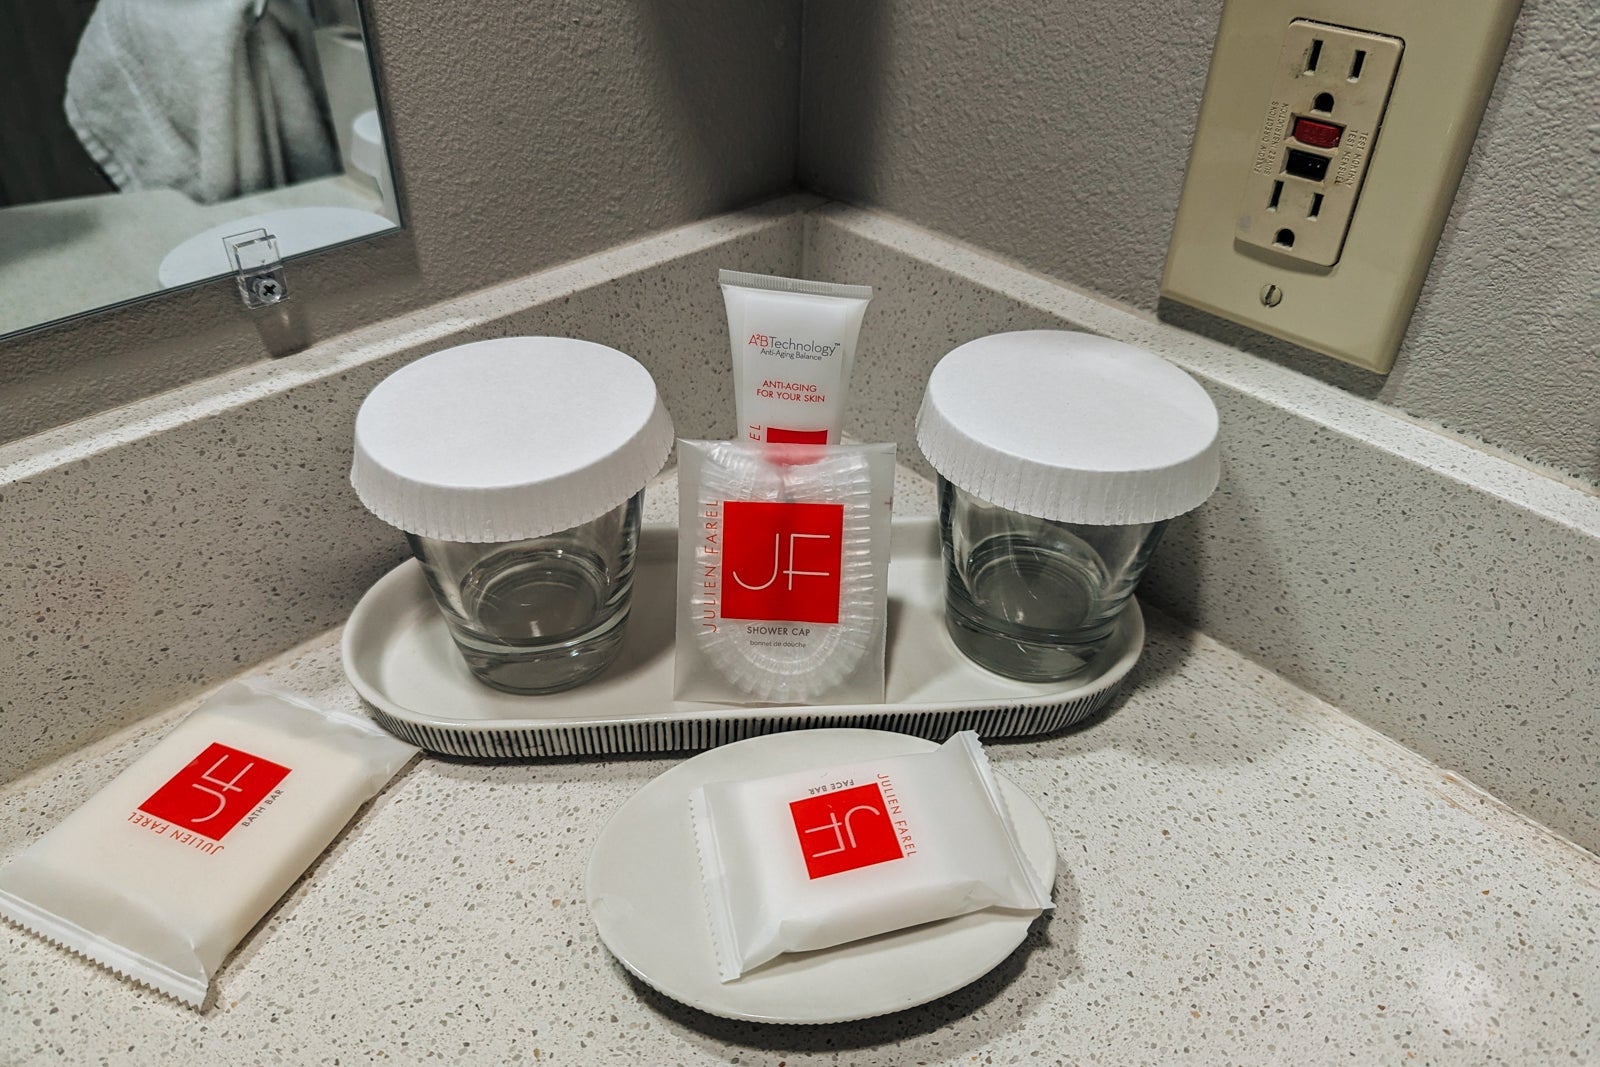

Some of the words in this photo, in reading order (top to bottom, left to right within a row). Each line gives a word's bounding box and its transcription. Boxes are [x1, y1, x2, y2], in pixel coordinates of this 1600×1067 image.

[760, 348, 795, 360] Anti-Aging
[795, 351, 822, 361] Balance
[756, 388, 774, 399] FOR
[776, 391, 801, 402] YOUR
[804, 394, 825, 403] SKIN
[762, 380, 817, 393] ANTI-AGING
[704, 500, 719, 555] FAREL
[732, 533, 831, 591] JF
[702, 565, 717, 633] JULIEN
[747, 626, 788, 637] SHOWER
[791, 627, 811, 637] CAP
[750, 640, 772, 648] bonnet
[773, 640, 782, 648] de
[782, 640, 806, 649] douche
[808, 785, 828, 795] BAR
[830, 778, 855, 790] FACE
[241, 806, 266, 827] BATH
[264, 788, 285, 806] BAR
[876, 773, 902, 815] JULIEN
[894, 819, 917, 857] FAREL
[127, 811, 170, 835] FAREL
[804, 805, 881, 858] JF
[169, 830, 225, 855] JULIEN
